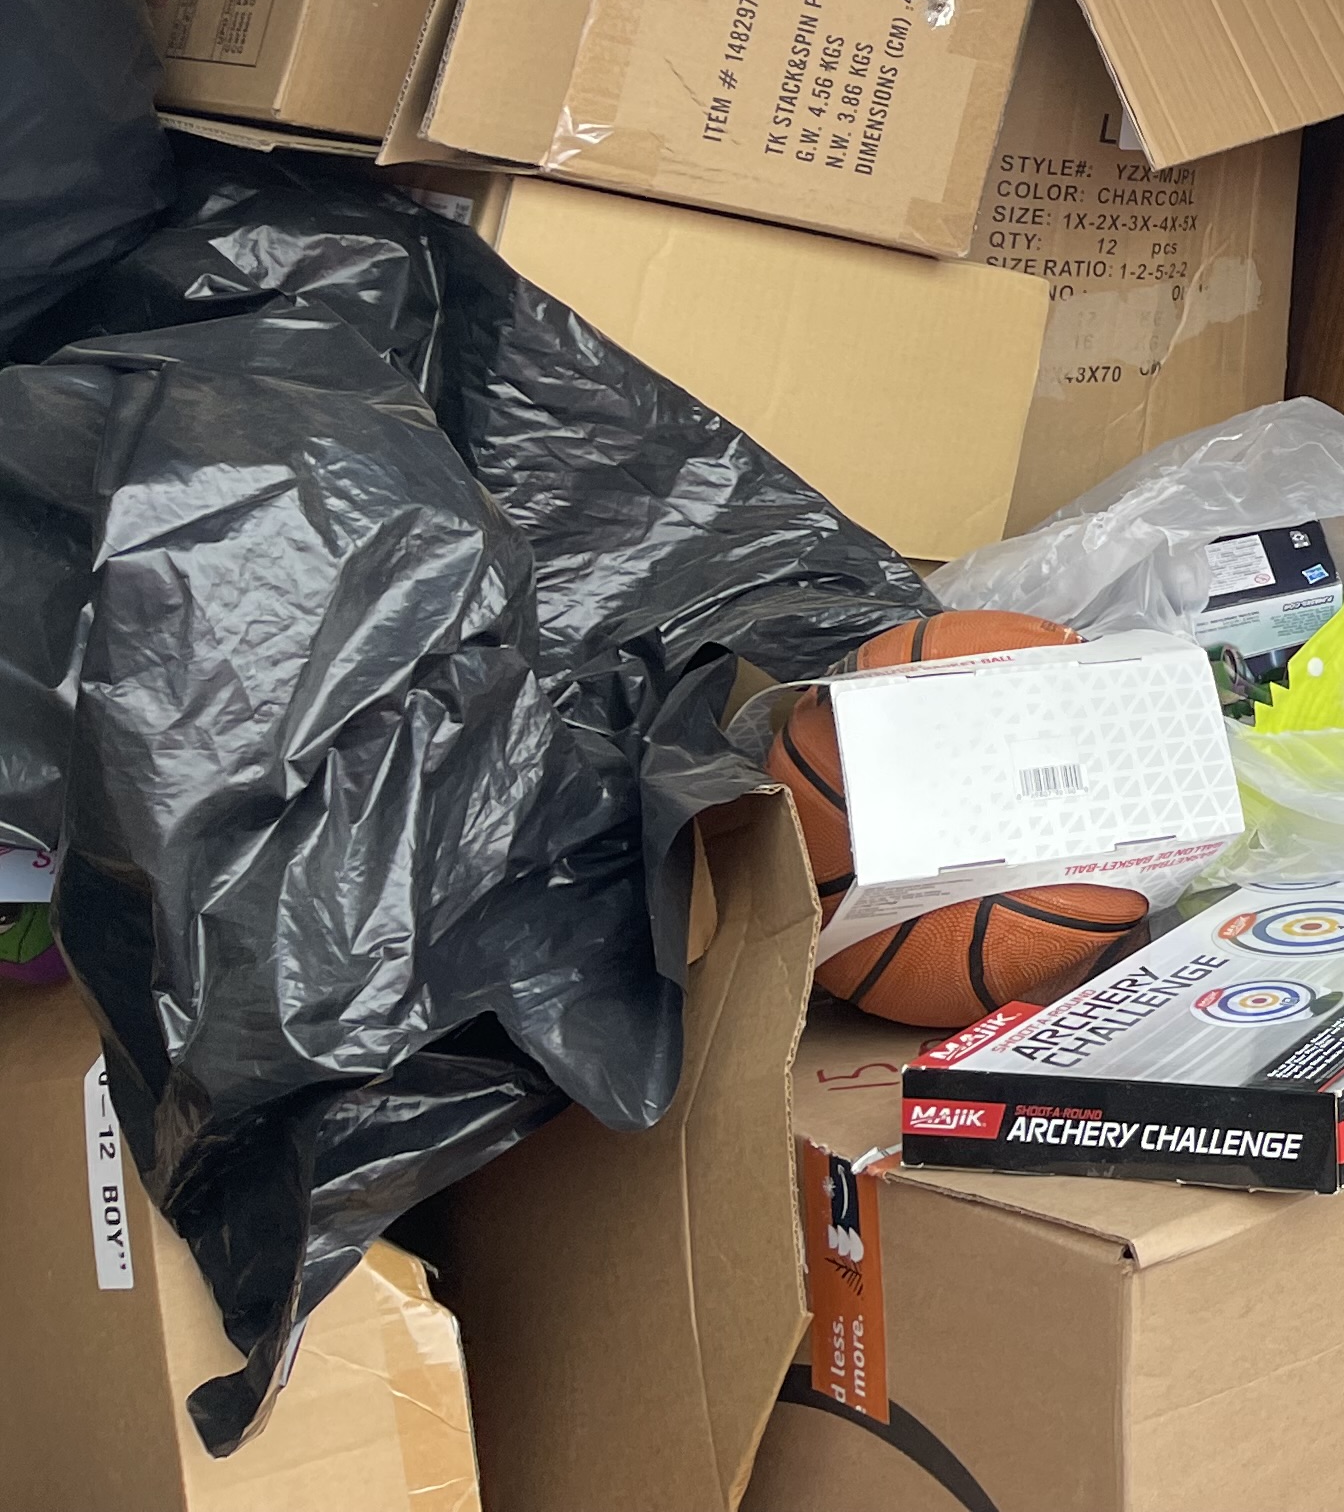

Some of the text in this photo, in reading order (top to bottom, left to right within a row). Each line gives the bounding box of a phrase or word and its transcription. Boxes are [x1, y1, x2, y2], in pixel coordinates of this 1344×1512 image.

[772, 14, 819, 128] STACK&SPIN
[795, 34, 845, 163] G.W. 4.56 KGS
[854, 64, 898, 176] DIMENSIONS
[885, 17, 912, 58] (CM)
[702, 96, 732, 142] ITEM
[718, 68, 738, 90] #
[825, 41, 874, 169] N.W. 3.86 KGS
[764, 132, 788, 155] TK
[1000, 154, 1093, 178] STYLE#:
[991, 205, 1199, 232] SIZE: 1X-2X-3X-4X-5X
[996, 180, 1195, 206] COLOR: CHARCOAL
[988, 231, 1178, 259] QTY: 12 pcs
[1043, 259, 1113, 278] RATIO:
[1120, 262, 1188, 280] 1-2-5-2-2
[1065, 854, 1155, 876] BASKET-BALL
[1011, 965, 1159, 1061] ARCHERY
[1041, 954, 1230, 1068] CHALLENGE
[1006, 1116, 1303, 1160] ARCHERY CHALLENGE
[830, 1315, 845, 1377] less.
[852, 1314, 866, 1397] more.
